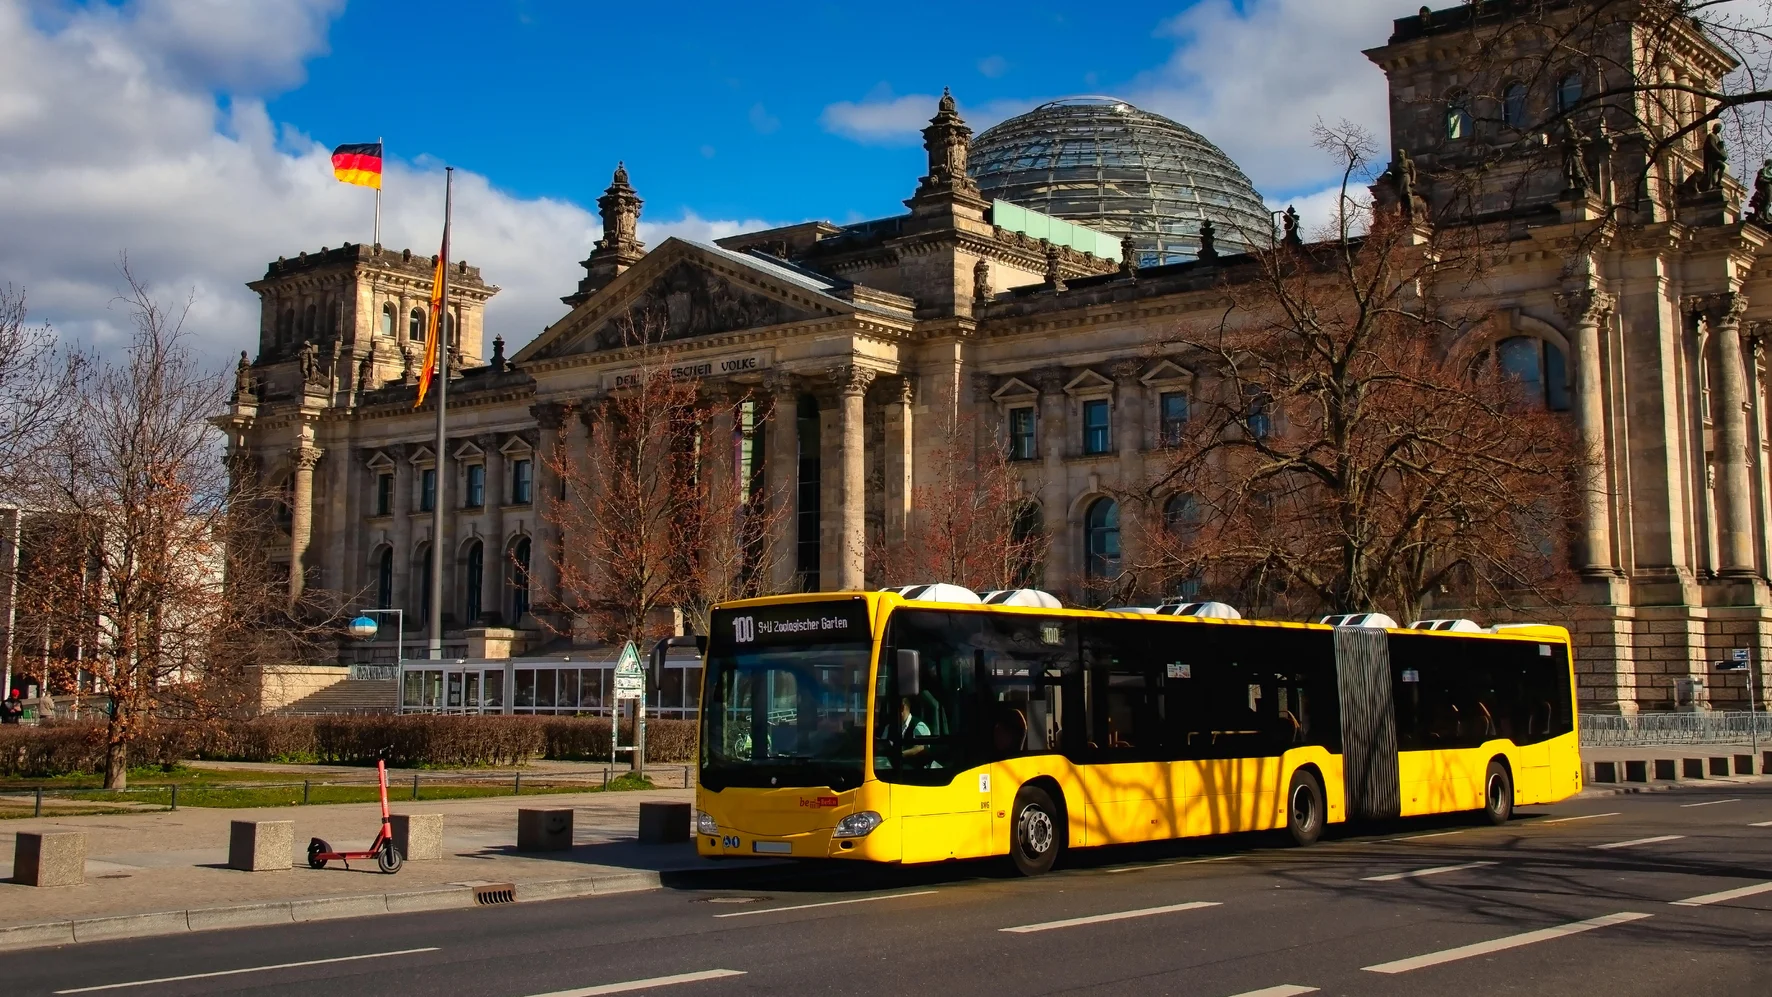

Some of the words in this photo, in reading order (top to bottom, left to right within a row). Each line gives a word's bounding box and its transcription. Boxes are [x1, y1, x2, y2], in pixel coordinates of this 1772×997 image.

[721, 357, 756, 371] VOLKE
[732, 616, 754, 643] 100
[758, 621, 772, 634] S+U
[774, 618, 819, 633] Zoologischer
[821, 616, 848, 630] Garten
[1045, 628, 1058, 643] 100
